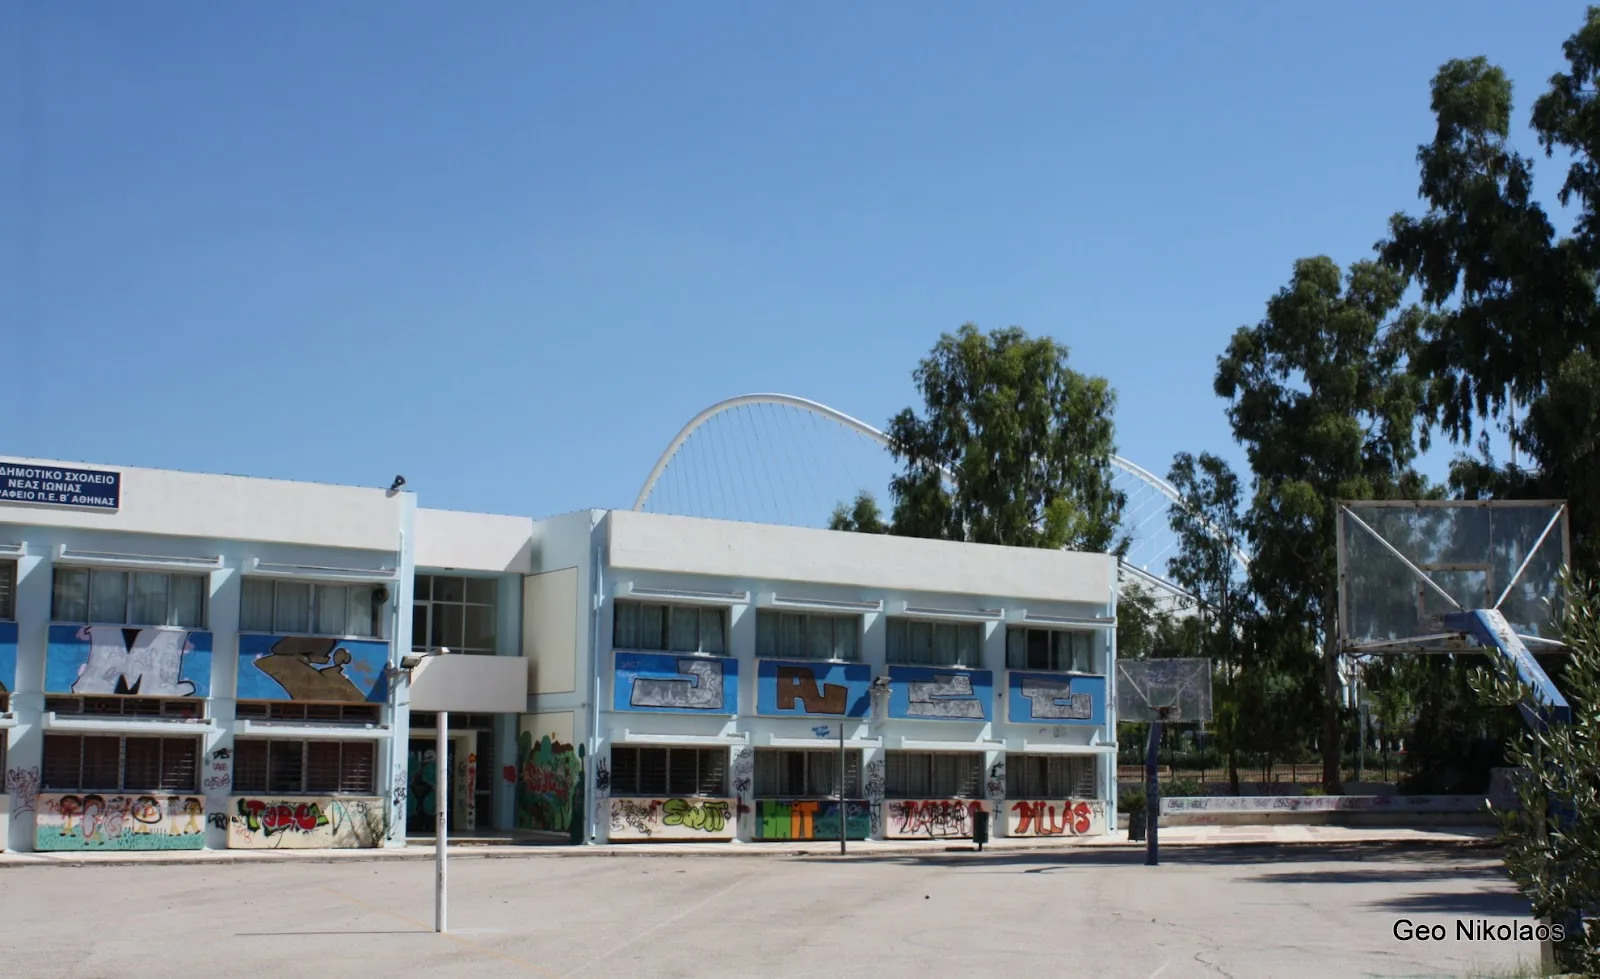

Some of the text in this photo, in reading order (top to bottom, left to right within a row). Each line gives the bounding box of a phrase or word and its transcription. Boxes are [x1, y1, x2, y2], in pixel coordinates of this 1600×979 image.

[0, 466, 115, 485] ΔΗΜΟΤΙΚΟ ΣΧΟΛΕΙΟ
[8, 479, 82, 493] ΝΕΑΣ ΙΩΝΙΑΣ
[0, 490, 35, 500] ΑΦΕΙΟ
[72, 495, 115, 506] ΑΘΗΝΑΣ
